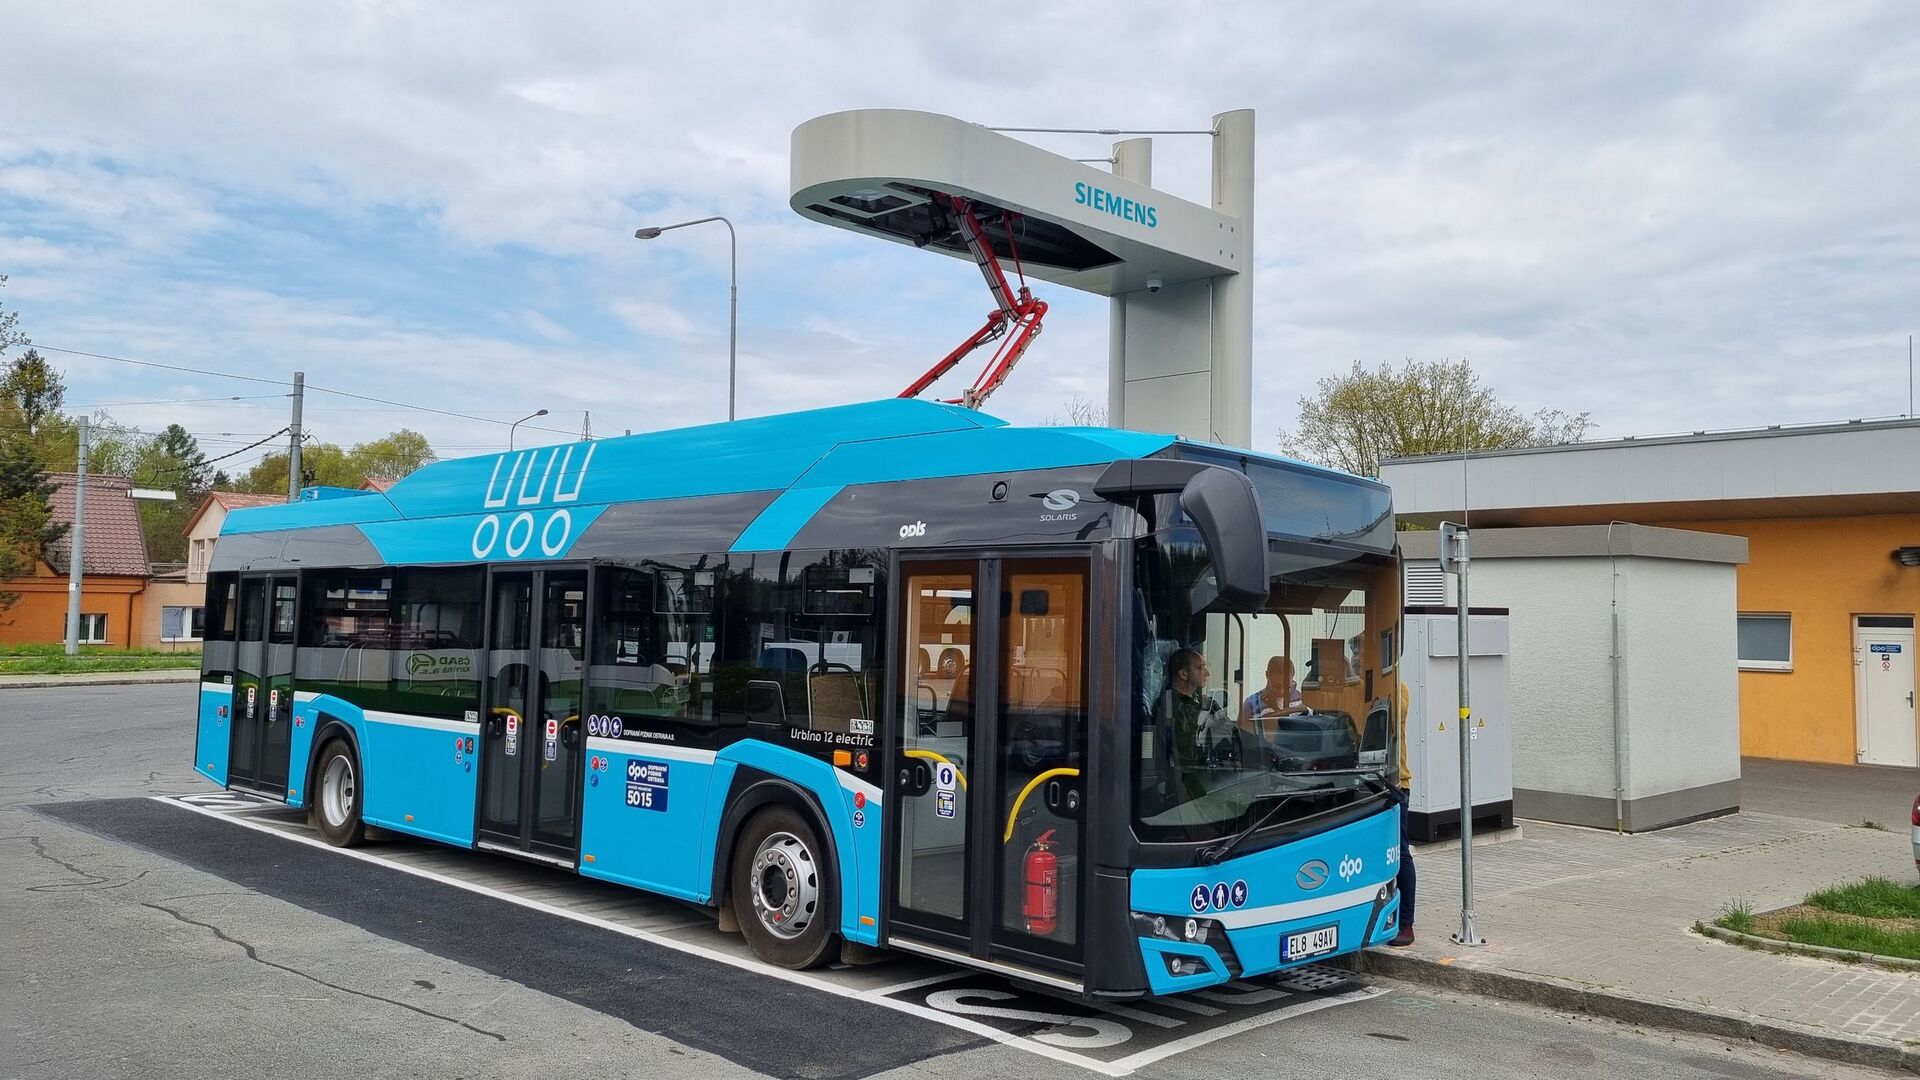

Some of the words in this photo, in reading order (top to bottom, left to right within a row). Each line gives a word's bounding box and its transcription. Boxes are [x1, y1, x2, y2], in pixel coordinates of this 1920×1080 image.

[1075, 182, 1157, 228] SIEMENS
[1040, 513, 1077, 522] SOLARIS
[790, 728, 822, 742] Urbino
[823, 731, 833, 743] 12
[835, 733, 874, 746] electric
[628, 761, 647, 781] dpo
[627, 790, 652, 807] 5015
[1339, 854, 1363, 883] dpo
[1290, 936, 1307, 955] EL8
[1313, 929, 1334, 949] 49AV
